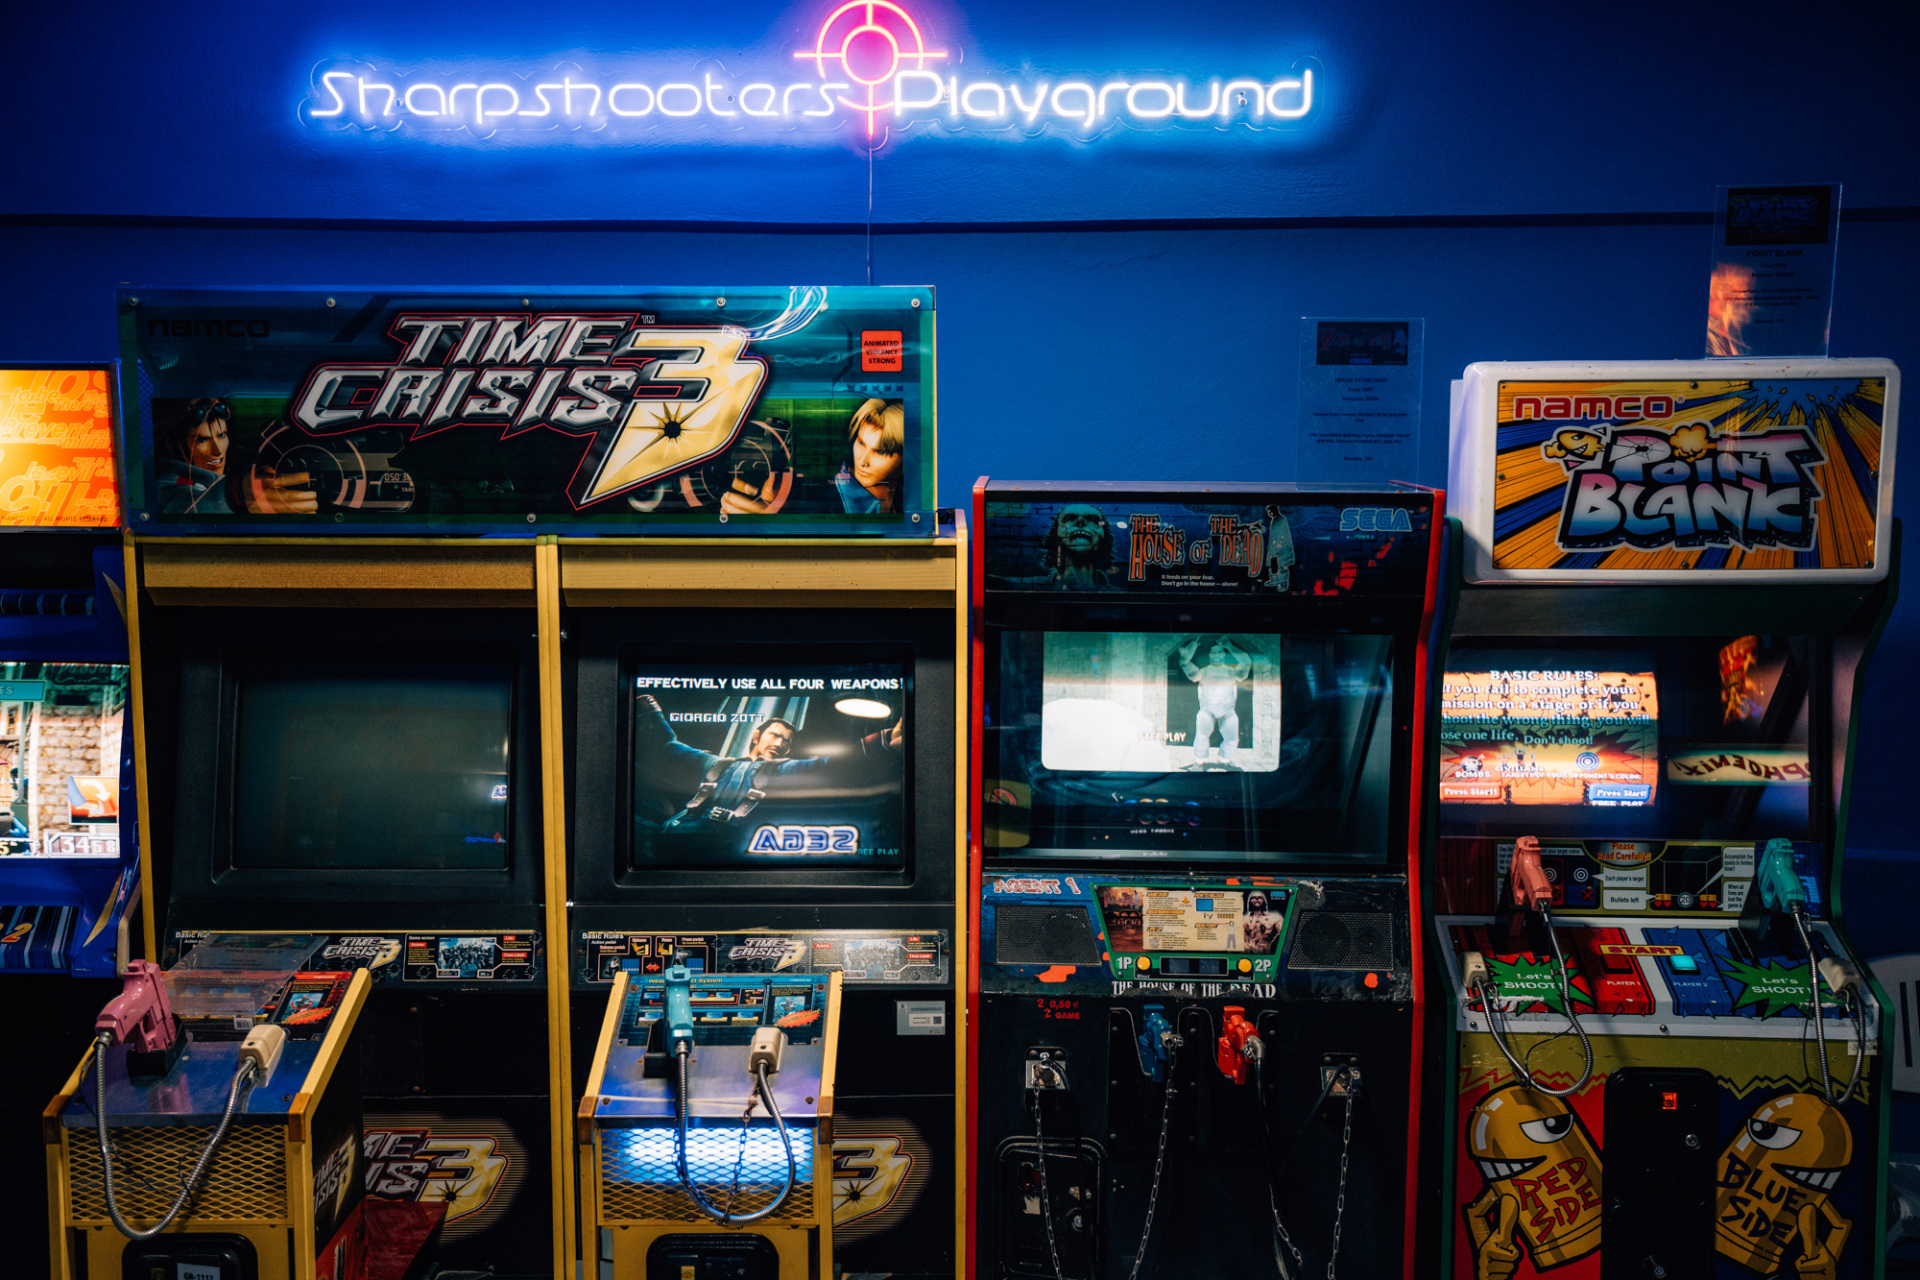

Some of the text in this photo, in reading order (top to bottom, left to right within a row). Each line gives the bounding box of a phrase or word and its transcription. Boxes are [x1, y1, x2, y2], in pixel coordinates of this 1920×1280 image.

[310, 69, 1313, 127] Sharpshooters Playground
[148, 318, 271, 339] namco
[398, 316, 632, 366] TIME
[863, 340, 899, 348] ANIMATED
[865, 348, 899, 356] VIOLENCE
[867, 357, 896, 365] STRONG
[1515, 396, 1674, 420] namco
[297, 328, 766, 506] CRISIS 3
[1568, 473, 1802, 537] BLANK
[1340, 507, 1413, 533] SEGA
[1128, 514, 1264, 581] THE HOUSE OF THE DEAD
[1489, 671, 1600, 681] BASIC RULES:
[636, 677, 903, 690] EFFECTIVELY USE ALL FOUR WEAPONS!
[1455, 686, 1481, 697] you
[1485, 684, 1509, 694] fail
[1514, 685, 1528, 694] to
[1531, 684, 1598, 698] complete
[1602, 686, 1635, 698] your
[1442, 698, 1494, 709] mission
[1497, 700, 1515, 709] on
[1518, 701, 1527, 709] a
[1578, 701, 1594, 710] or
[1597, 699, 1609, 710] if
[1613, 702, 1639, 713] you
[669, 712, 727, 723] GIORGIO
[1476, 714, 1499, 725] the
[1502, 717, 1549, 728] wrong
[1597, 717, 1624, 728] you
[1627, 714, 1650, 725] will
[1164, 732, 1187, 742] PLAY
[1441, 729, 1519, 741] ose one life.
[1523, 734, 1594, 745] Don't shoot!
[1444, 788, 1498, 796] Press Start!
[1596, 789, 1647, 798] Press Start!
[1612, 842, 1636, 851] Please
[994, 877, 1081, 895] AGENT 1
[1680, 896, 1690, 904] 20
[340, 937, 379, 947] TIME
[746, 938, 783, 948] TIME
[323, 946, 380, 959] CRISIS
[729, 947, 786, 959] CRISIS
[1608, 946, 1679, 955] START
[1116, 956, 1133, 970] 1P
[1254, 959, 1272, 972] 2P
[1761, 976, 1799, 985] Let's
[1201, 983, 1223, 997] THE
[1036, 998, 1045, 1008] 2
[1044, 1008, 1080, 1020] 2 GAME
[1511, 1156, 1588, 1212] RED
[1716, 1151, 1807, 1217] BLUE
[1529, 1181, 1602, 1244] SIDE
[1721, 1195, 1797, 1249] SIDE
